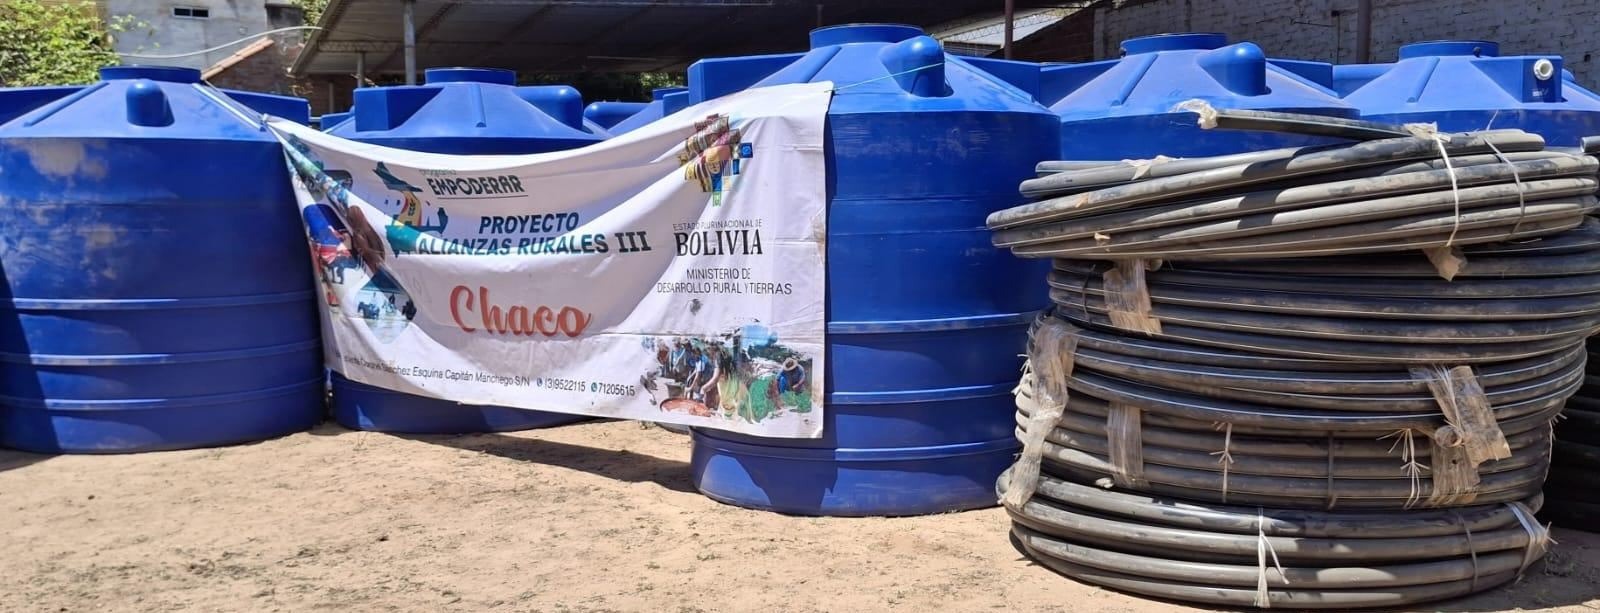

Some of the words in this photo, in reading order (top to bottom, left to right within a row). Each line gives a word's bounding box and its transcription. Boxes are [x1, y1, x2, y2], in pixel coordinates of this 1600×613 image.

[426, 175, 525, 195] EMPODERAR
[478, 212, 580, 234] PROYECTO
[673, 222, 700, 231] ESTADO
[418, 237, 512, 256] ALIANZAS
[517, 233, 609, 256] RURALES
[614, 231, 652, 253] III
[674, 229, 763, 256] BOLIVIA
[686, 268, 740, 280] MINISTERIO
[657, 282, 711, 294] DESARROLLO
[713, 282, 742, 294] RURAL
[450, 285, 592, 338] Chaco
[413, 366, 443, 380] Esquina
[445, 369, 473, 382] Capitán
[475, 371, 513, 387] Manchego
[514, 375, 530, 387] S/N
[545, 377, 586, 392] (3)9522115
[598, 382, 635, 397] 71205615
